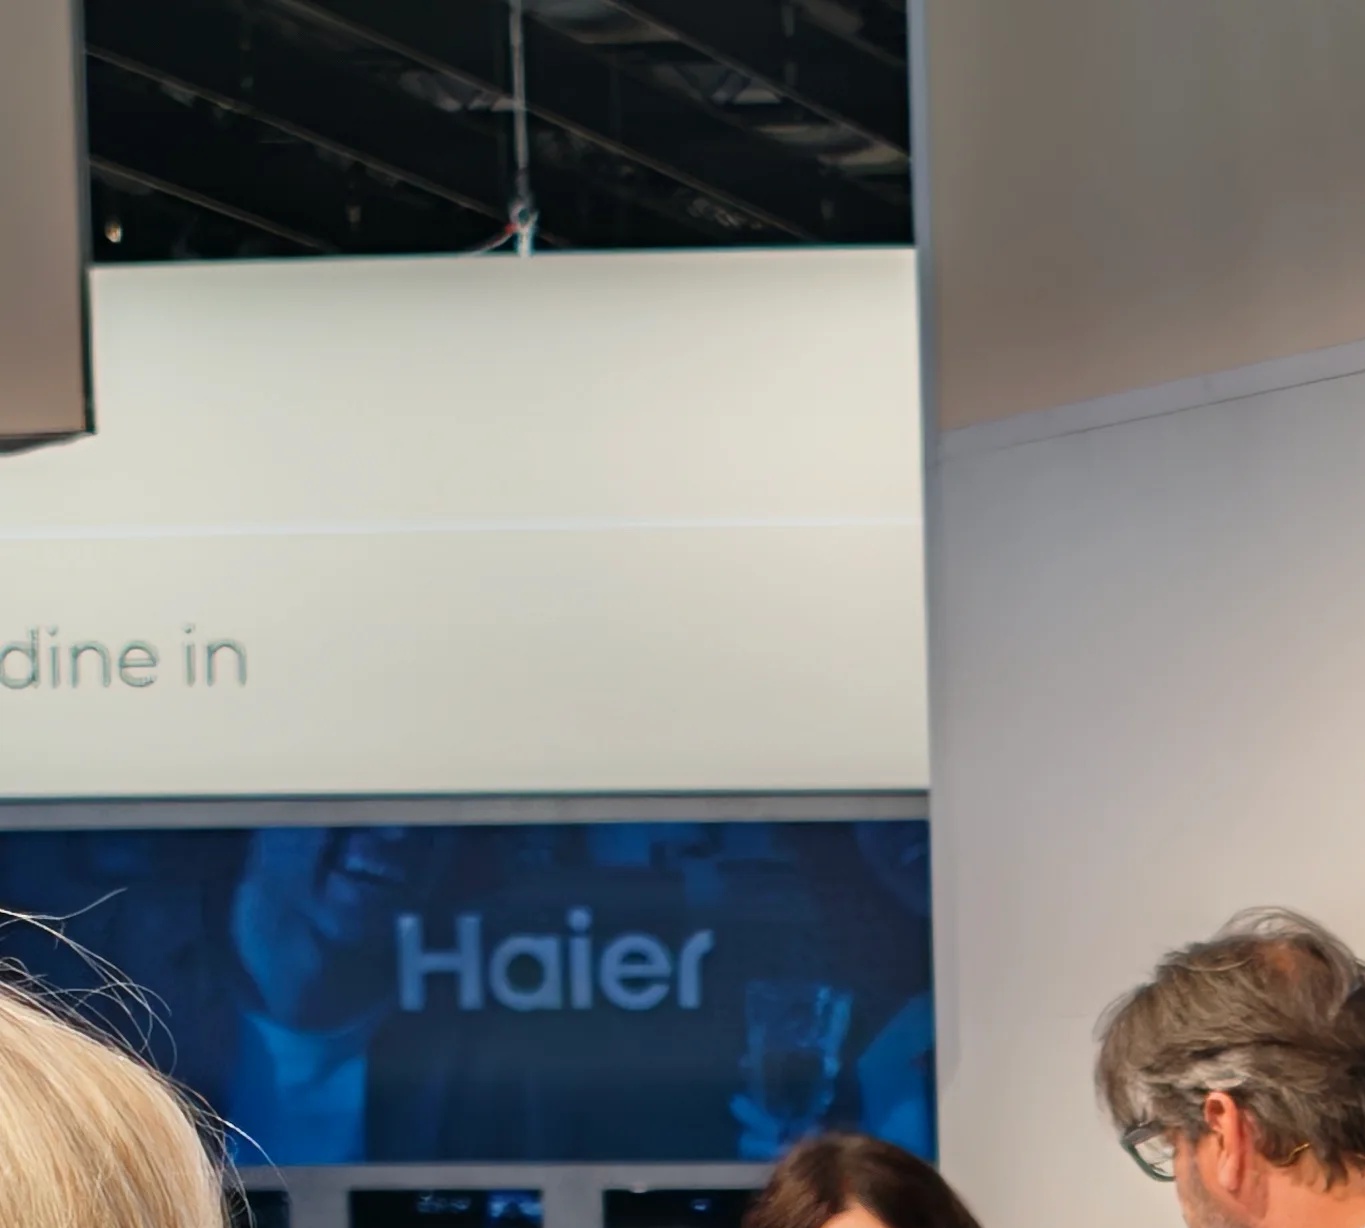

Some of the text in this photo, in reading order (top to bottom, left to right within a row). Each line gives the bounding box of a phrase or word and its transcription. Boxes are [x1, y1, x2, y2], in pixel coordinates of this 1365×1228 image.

[0, 622, 248, 689] dine in
[396, 906, 715, 1012] Haier
